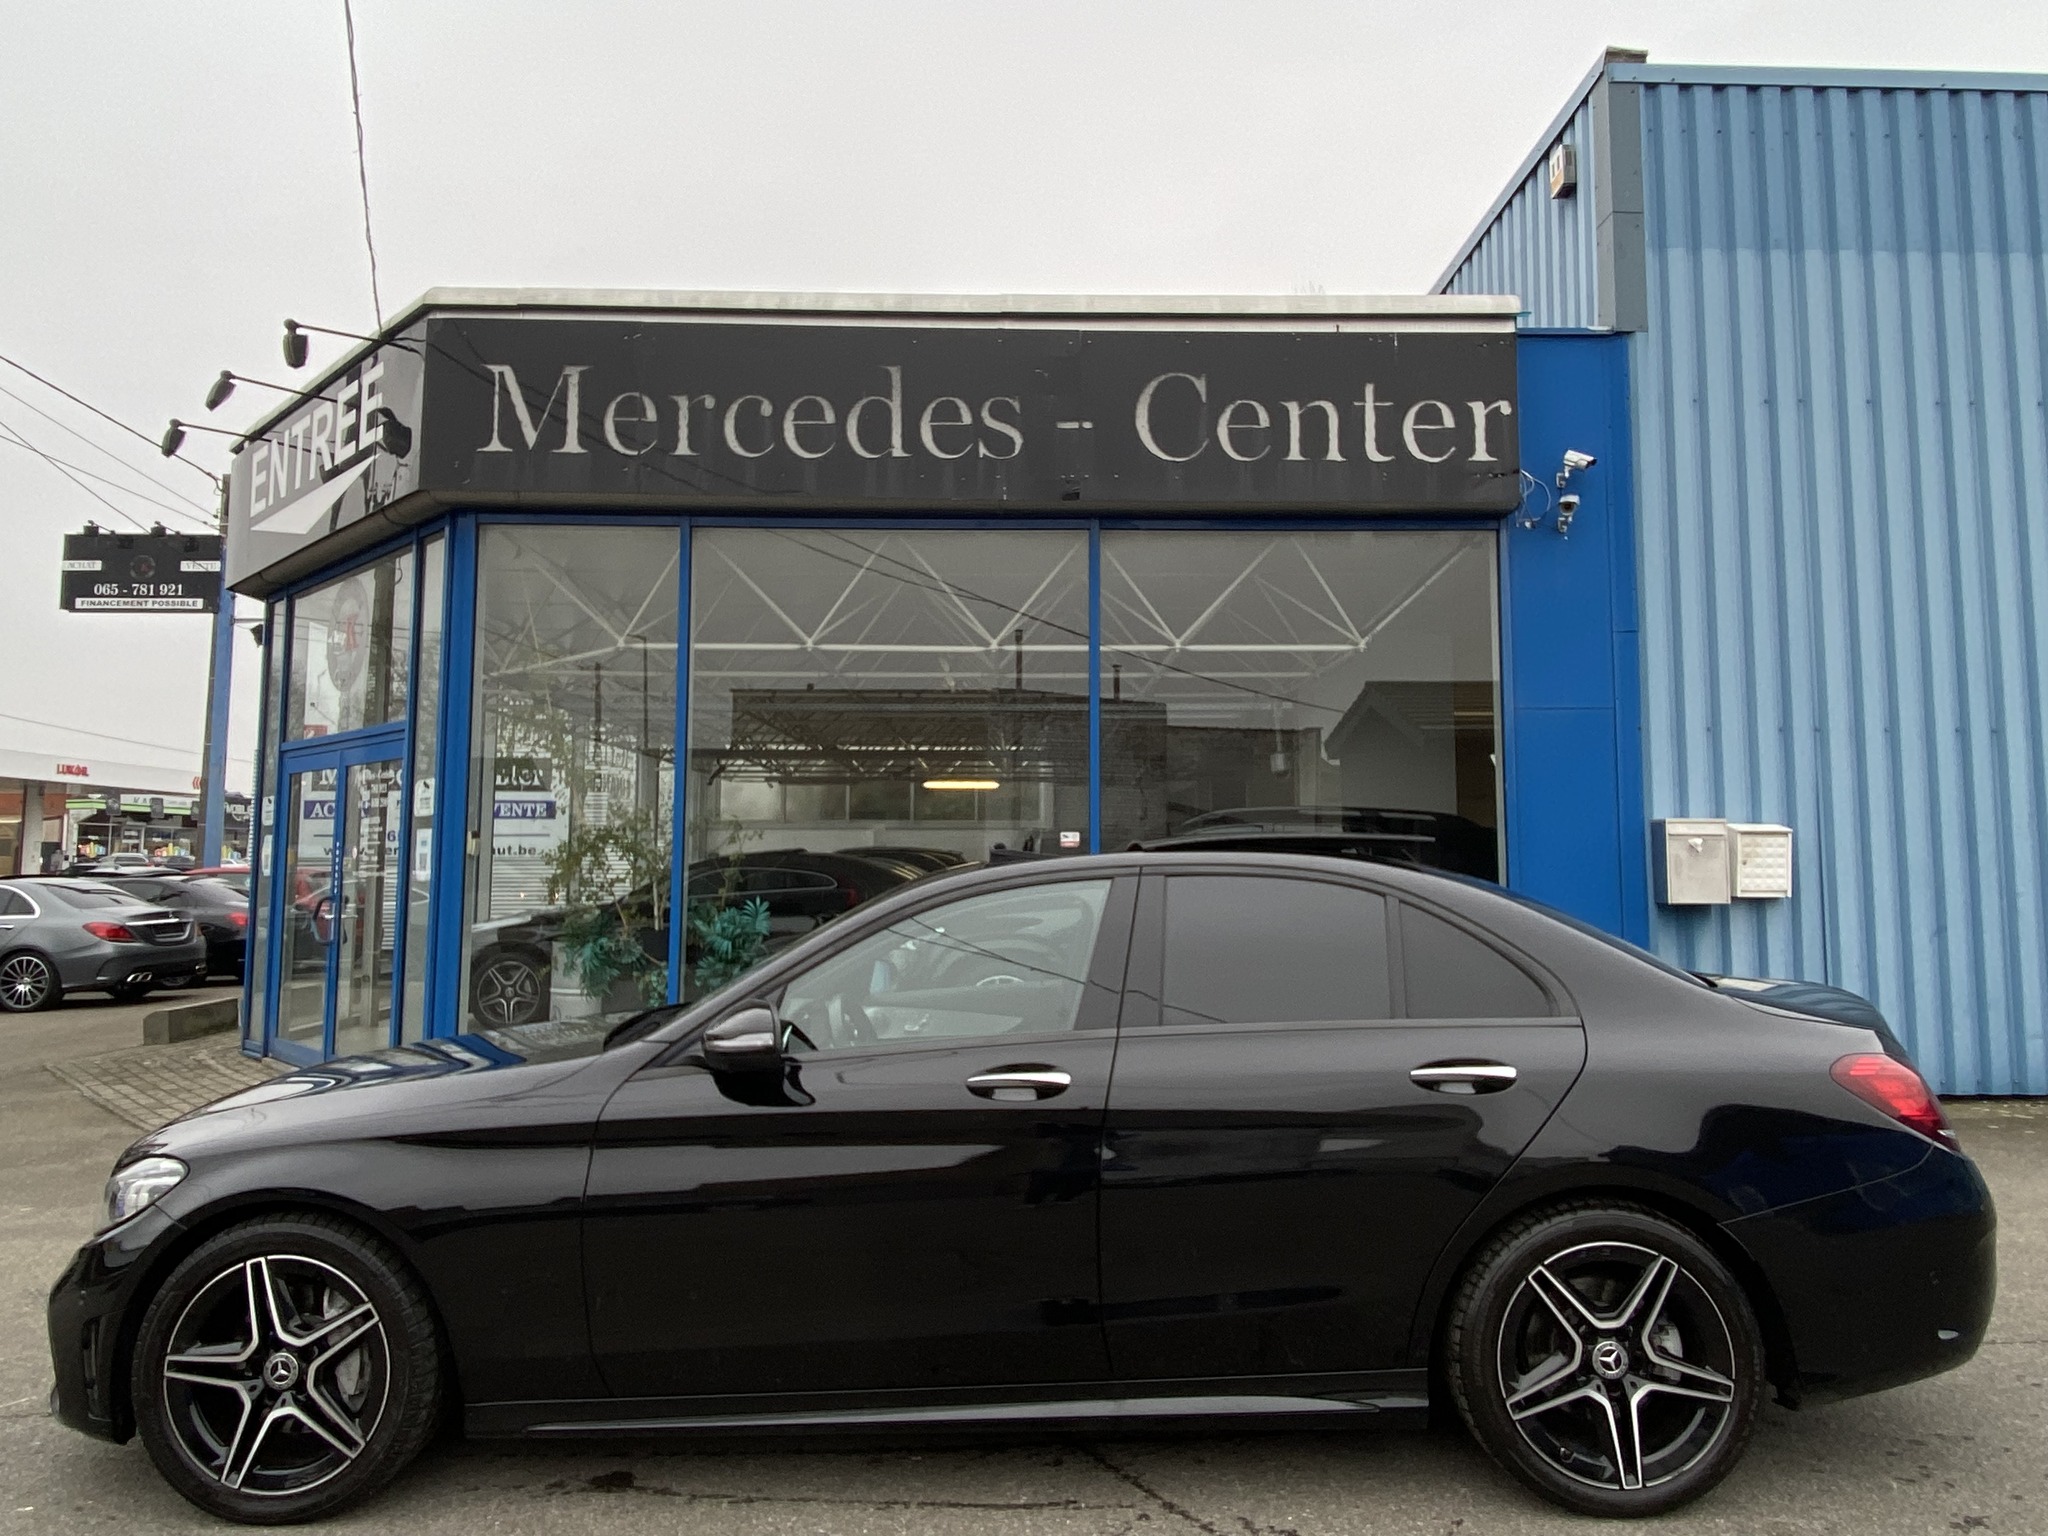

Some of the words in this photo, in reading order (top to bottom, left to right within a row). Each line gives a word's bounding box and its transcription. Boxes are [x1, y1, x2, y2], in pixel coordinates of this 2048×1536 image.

[476, 364, 1024, 459] Mercedes
[1135, 372, 1512, 463] Center
[94, 583, 119, 596] 065
[132, 583, 155, 596] 781
[159, 583, 184, 596] 921
[80, 599, 149, 608] FINANCEMENT
[151, 600, 199, 608] POSSIBLE
